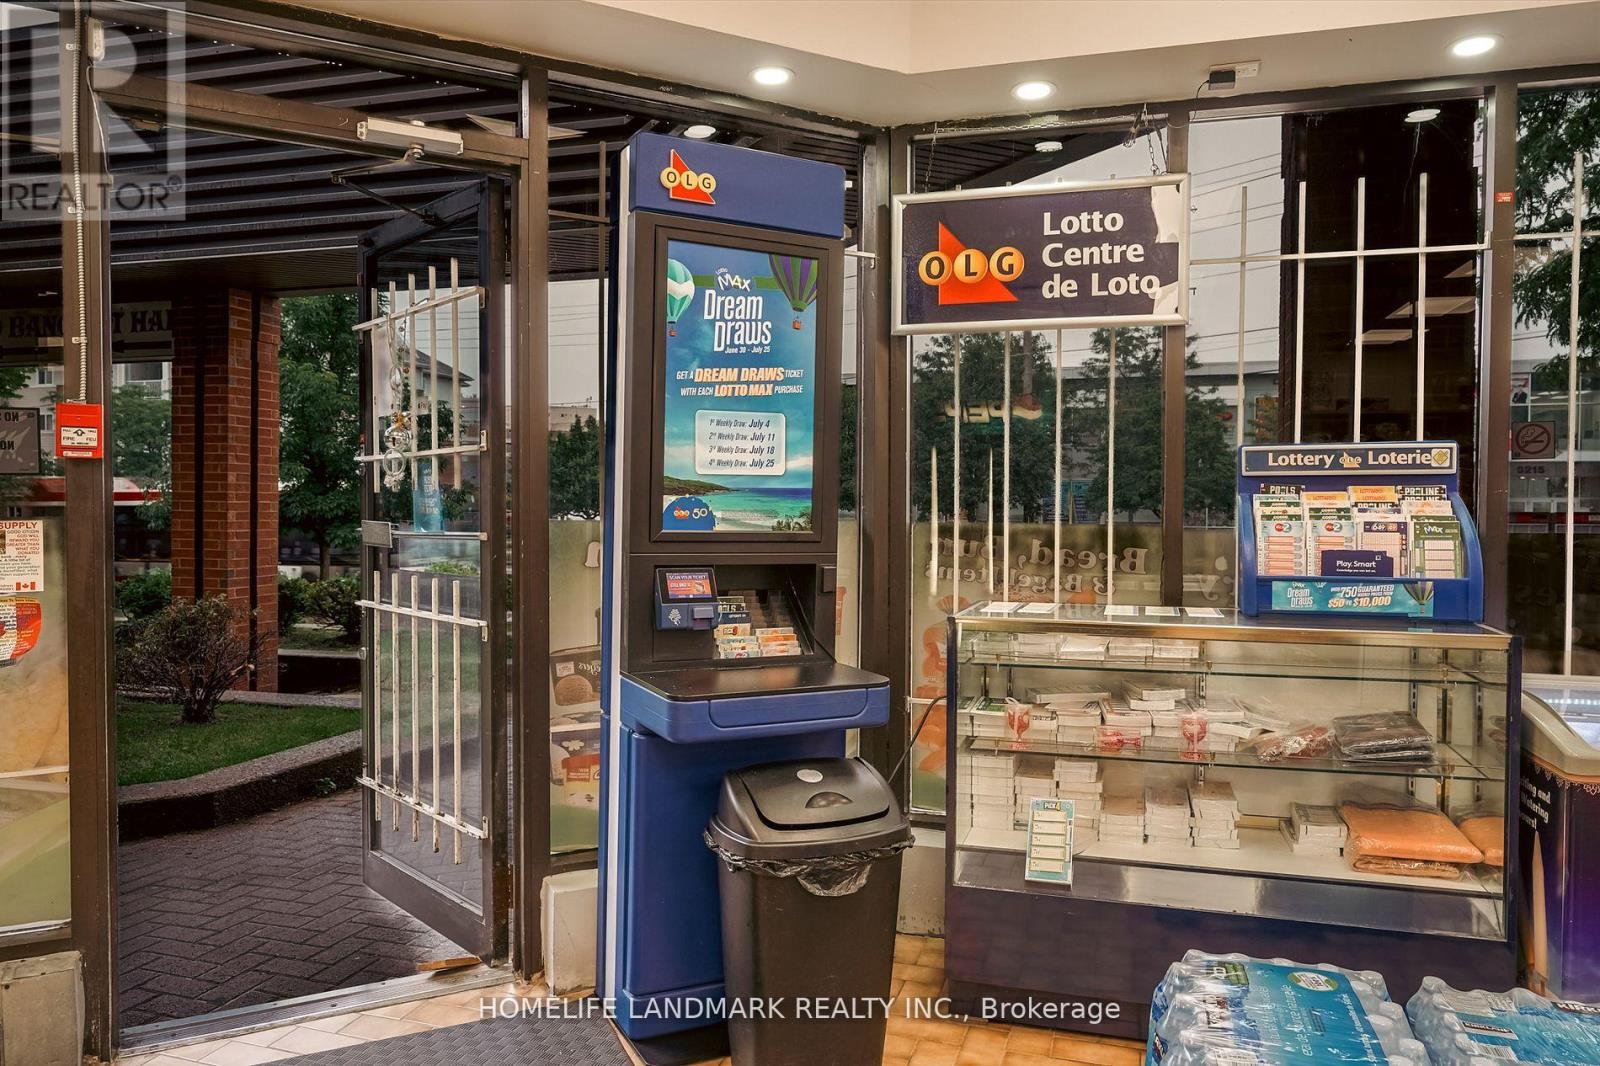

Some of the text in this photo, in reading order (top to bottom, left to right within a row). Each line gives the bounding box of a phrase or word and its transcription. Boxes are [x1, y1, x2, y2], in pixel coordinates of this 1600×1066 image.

[664, 170, 713, 191] OLG
[1043, 210, 1124, 236] Lotto
[1042, 242, 1144, 268] Centre
[921, 249, 1019, 282] OLG
[718, 274, 751, 292] MAX
[1042, 272, 1160, 299] de Loto
[703, 289, 763, 320] Dream
[713, 321, 772, 352] Draws
[751, 346, 763, 354] July
[676, 367, 804, 382] GET A DREAM DRAWS TICKET
[680, 384, 804, 397] WITH EACH LOTTO MAX PURCHASE
[716, 419, 733, 428] Weekly
[749, 419, 764, 429] July
[765, 419, 770, 428] 4
[718, 432, 735, 441] Weekly
[750, 432, 766, 443] July
[768, 433, 775, 441] 11
[717, 445, 735, 454] Weekly
[749, 445, 765, 456] July
[767, 446, 775, 454] 18
[717, 459, 735, 467] Weekly
[749, 458, 765, 469] July
[766, 459, 775, 467] 25
[1268, 452, 1335, 469] Lottery
[1368, 450, 1432, 465] Loterie
[1336, 560, 1377, 568] Play Smart
[1287, 588, 1310, 598] Dream
[1341, 586, 1357, 598] 750
[1358, 584, 1394, 593] GUARANTEED
[1291, 597, 1313, 608] Draws
[1353, 595, 1391, 607] $10,000
